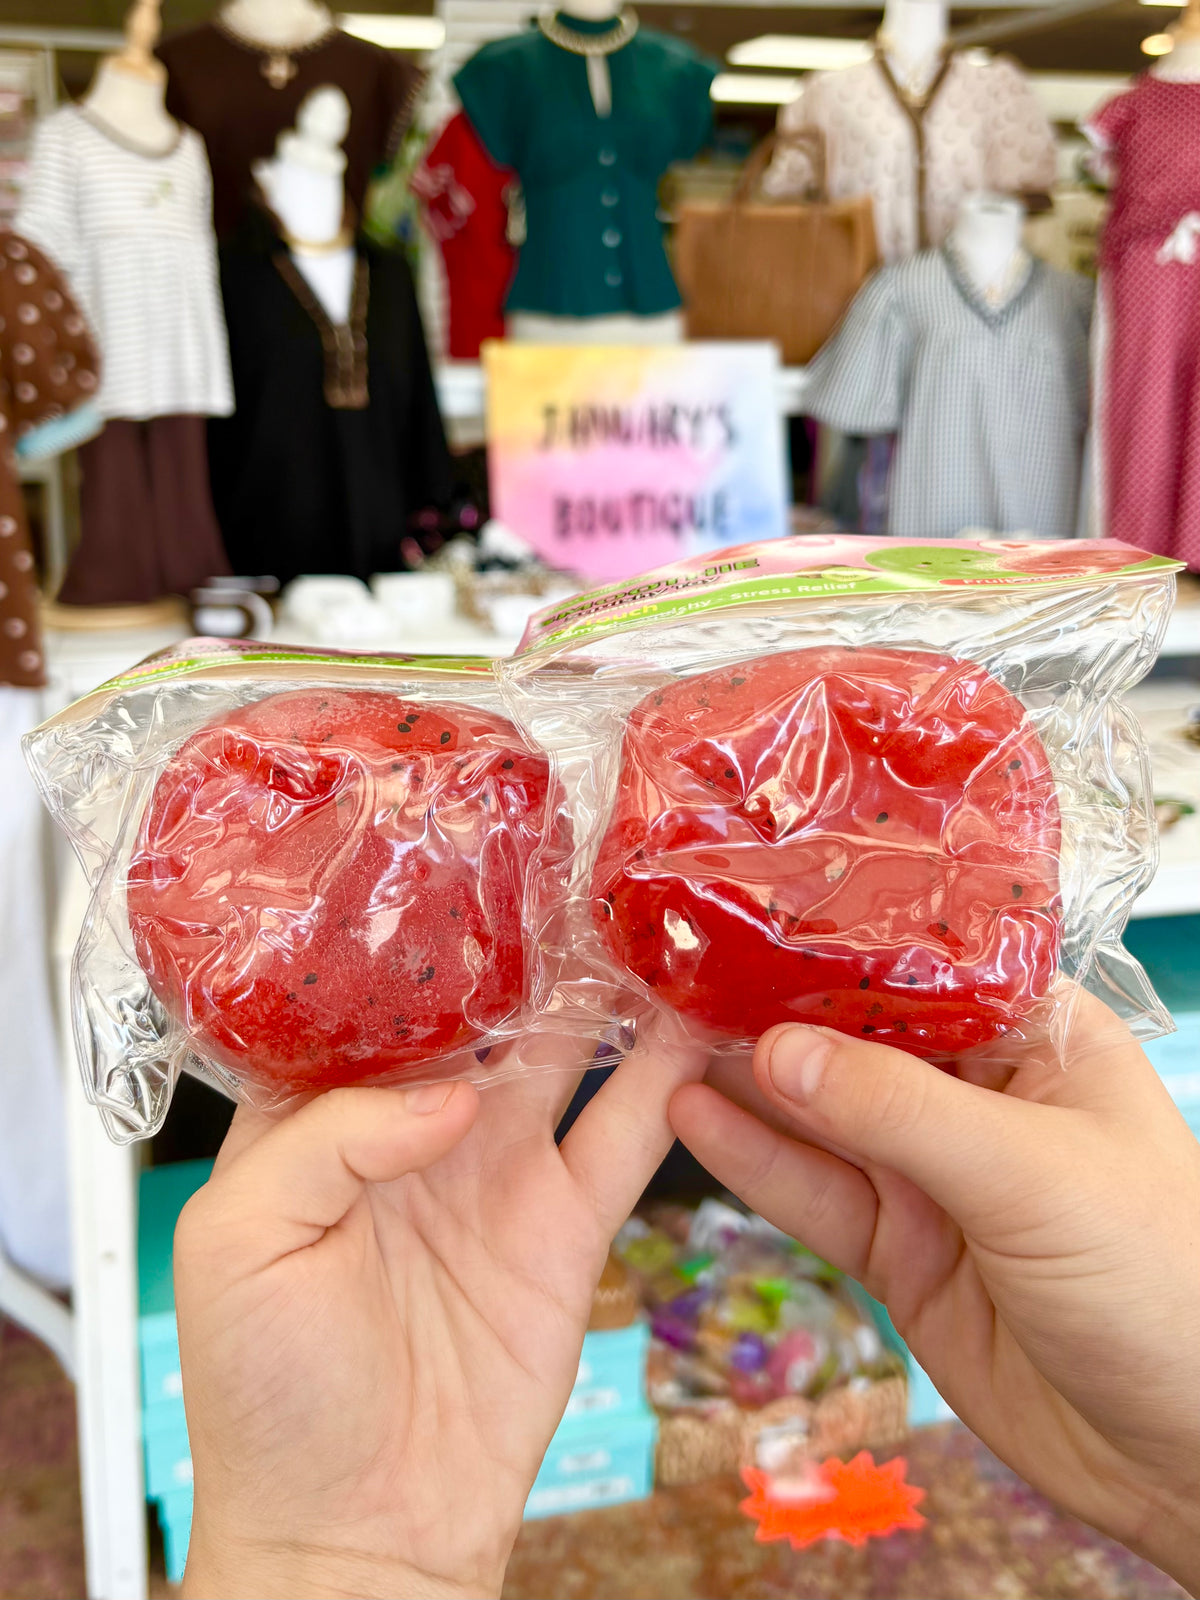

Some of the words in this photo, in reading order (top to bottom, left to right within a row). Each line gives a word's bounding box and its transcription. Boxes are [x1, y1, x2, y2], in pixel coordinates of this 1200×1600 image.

[542, 403, 734, 448] JANUARY'S
[554, 491, 729, 539] BOUTIQUE
[729, 586, 791, 600] Stress
[797, 582, 857, 593] Relief
